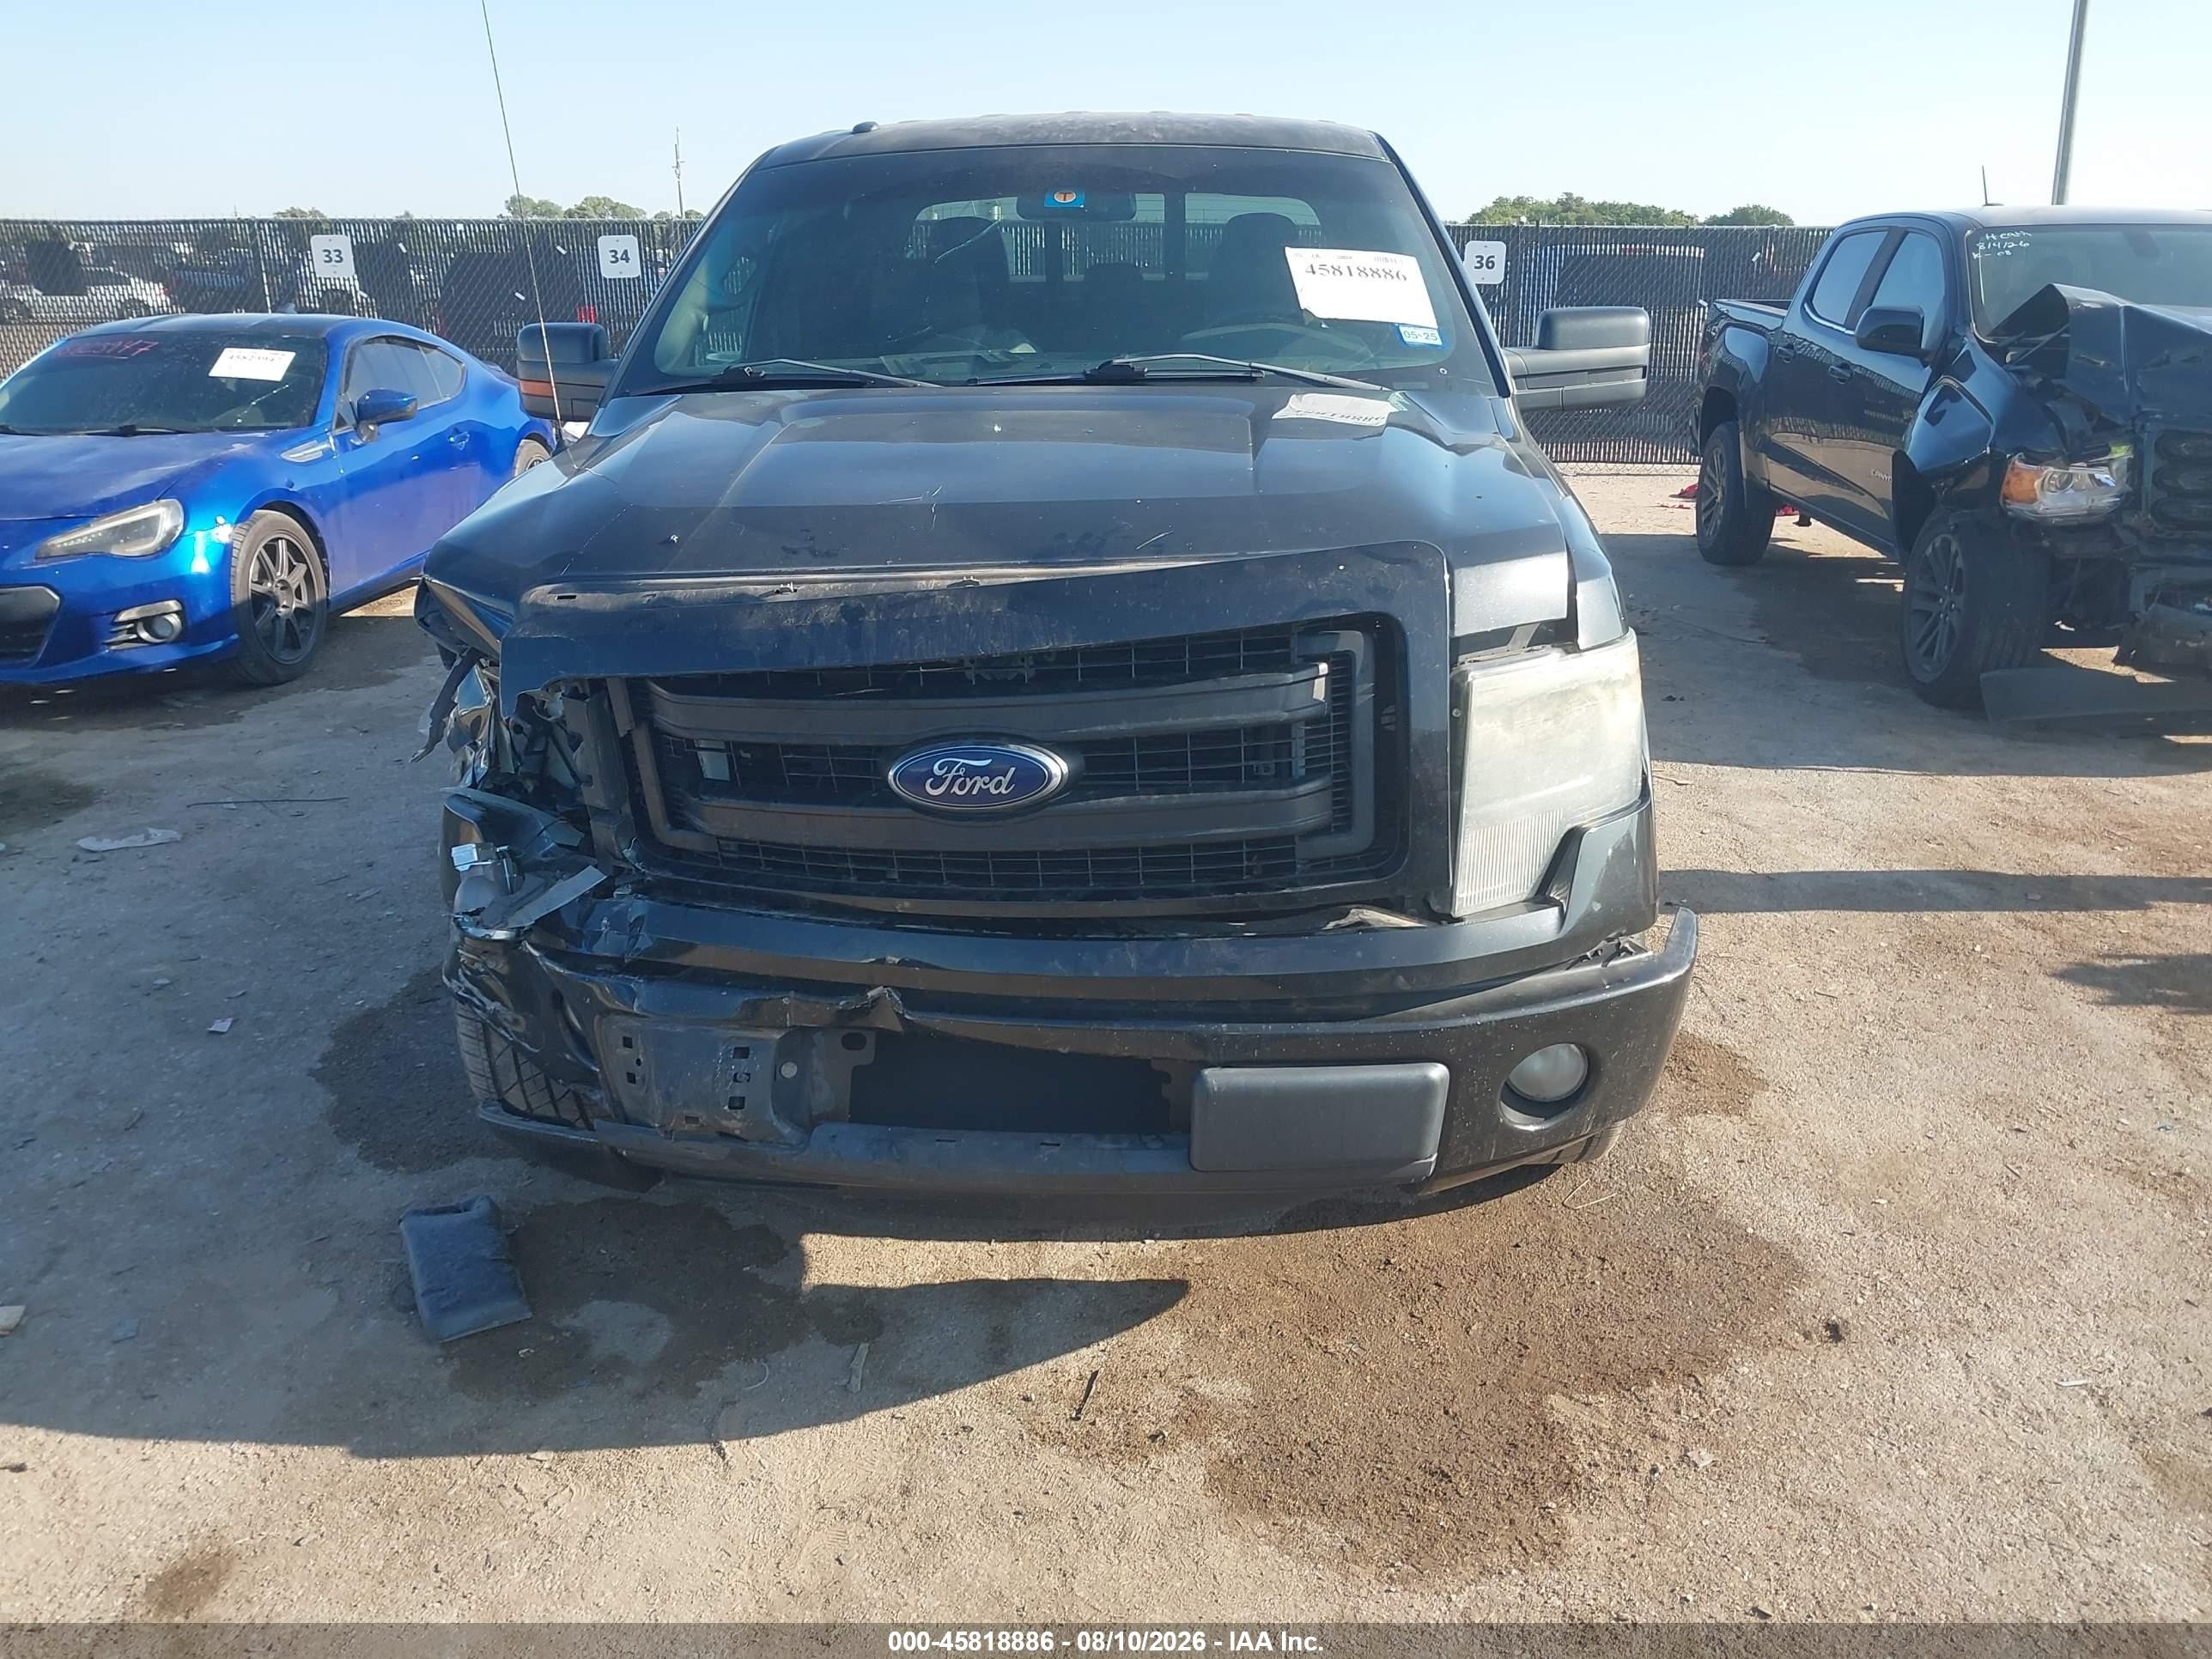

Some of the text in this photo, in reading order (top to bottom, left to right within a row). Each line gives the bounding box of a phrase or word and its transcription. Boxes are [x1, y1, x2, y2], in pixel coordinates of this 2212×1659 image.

[322, 248, 343, 264] 33
[609, 248, 630, 264] 34
[1474, 254, 1496, 270] 36
[1304, 263, 1407, 283] 45818886
[925, 757, 1017, 796] Ford
